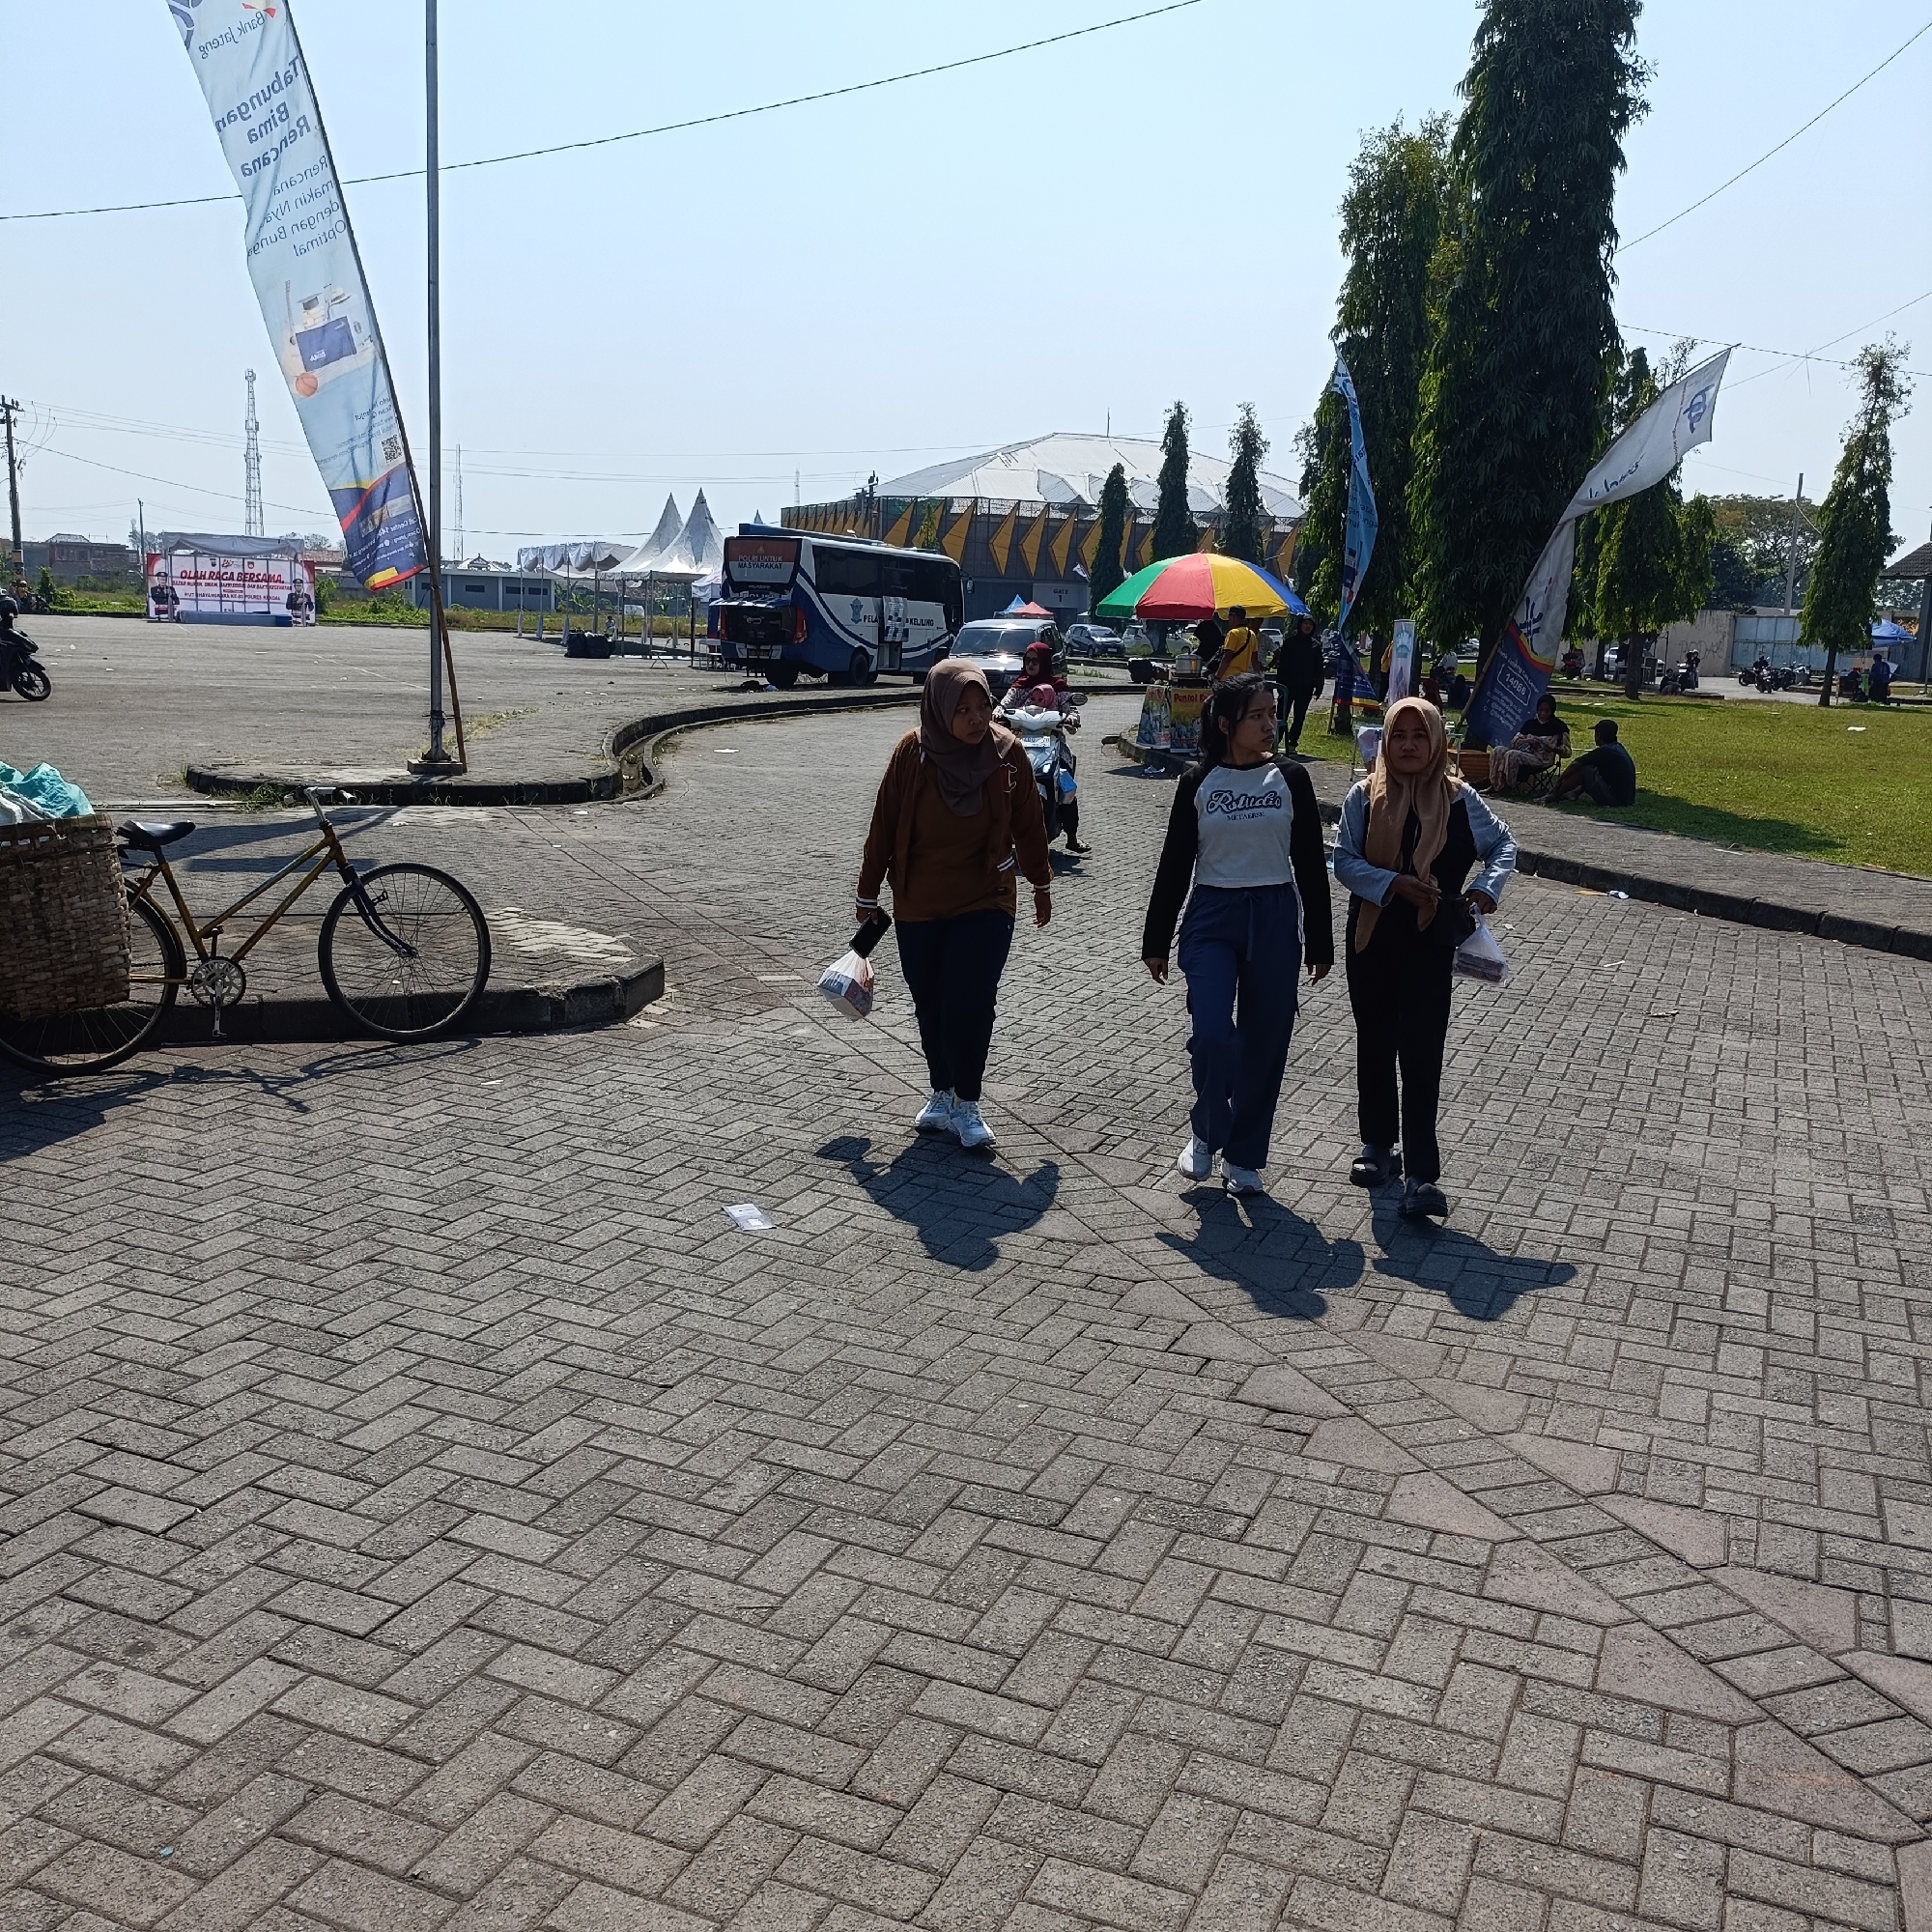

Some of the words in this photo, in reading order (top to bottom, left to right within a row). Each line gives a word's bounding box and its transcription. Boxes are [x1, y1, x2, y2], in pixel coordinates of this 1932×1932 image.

[180, 570, 207, 581] OLAH
[209, 571, 234, 581] RAGA
[1058, 594, 1063, 603] 1
